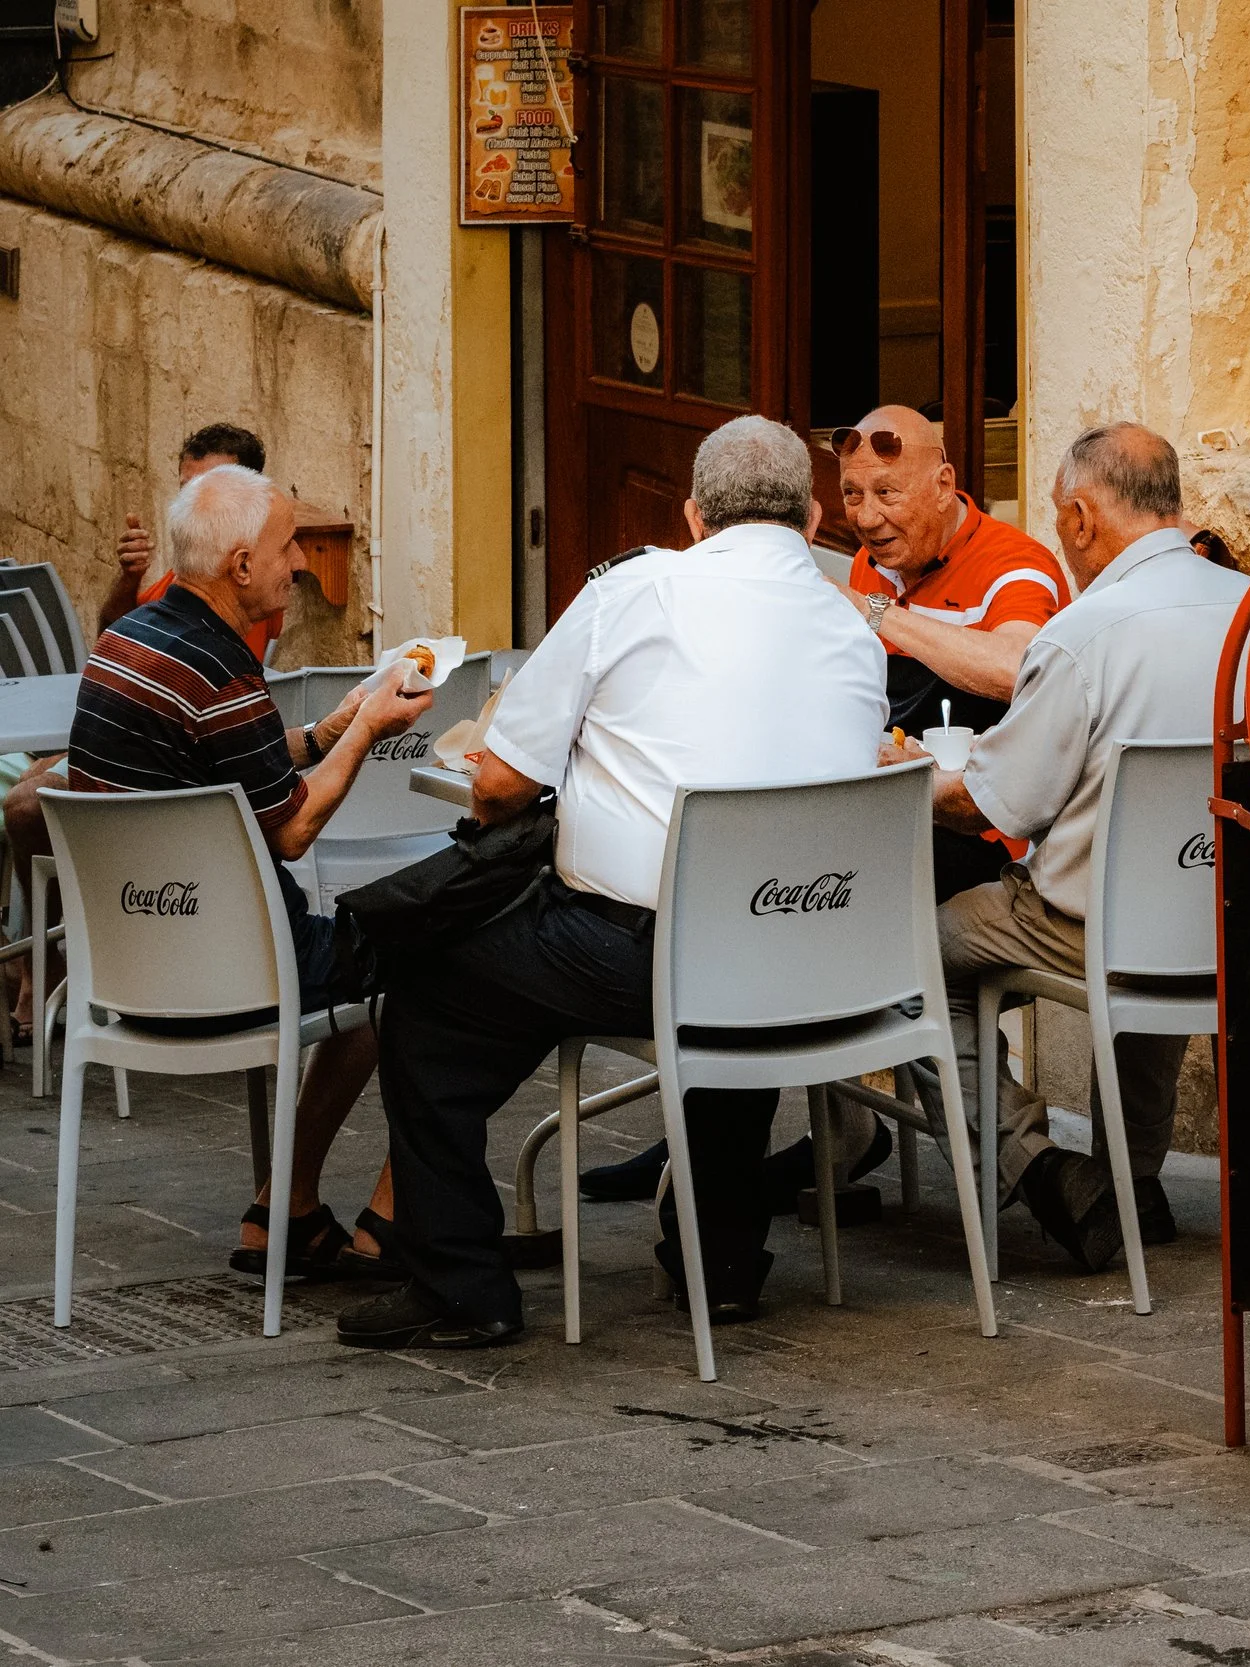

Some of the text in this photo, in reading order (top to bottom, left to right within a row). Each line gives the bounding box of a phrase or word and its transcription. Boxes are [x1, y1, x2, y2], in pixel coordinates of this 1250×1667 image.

[516, 110, 554, 125] FOOD
[121, 881, 200, 916] Coca-Cola
[750, 869, 859, 916] Coca-Cola
